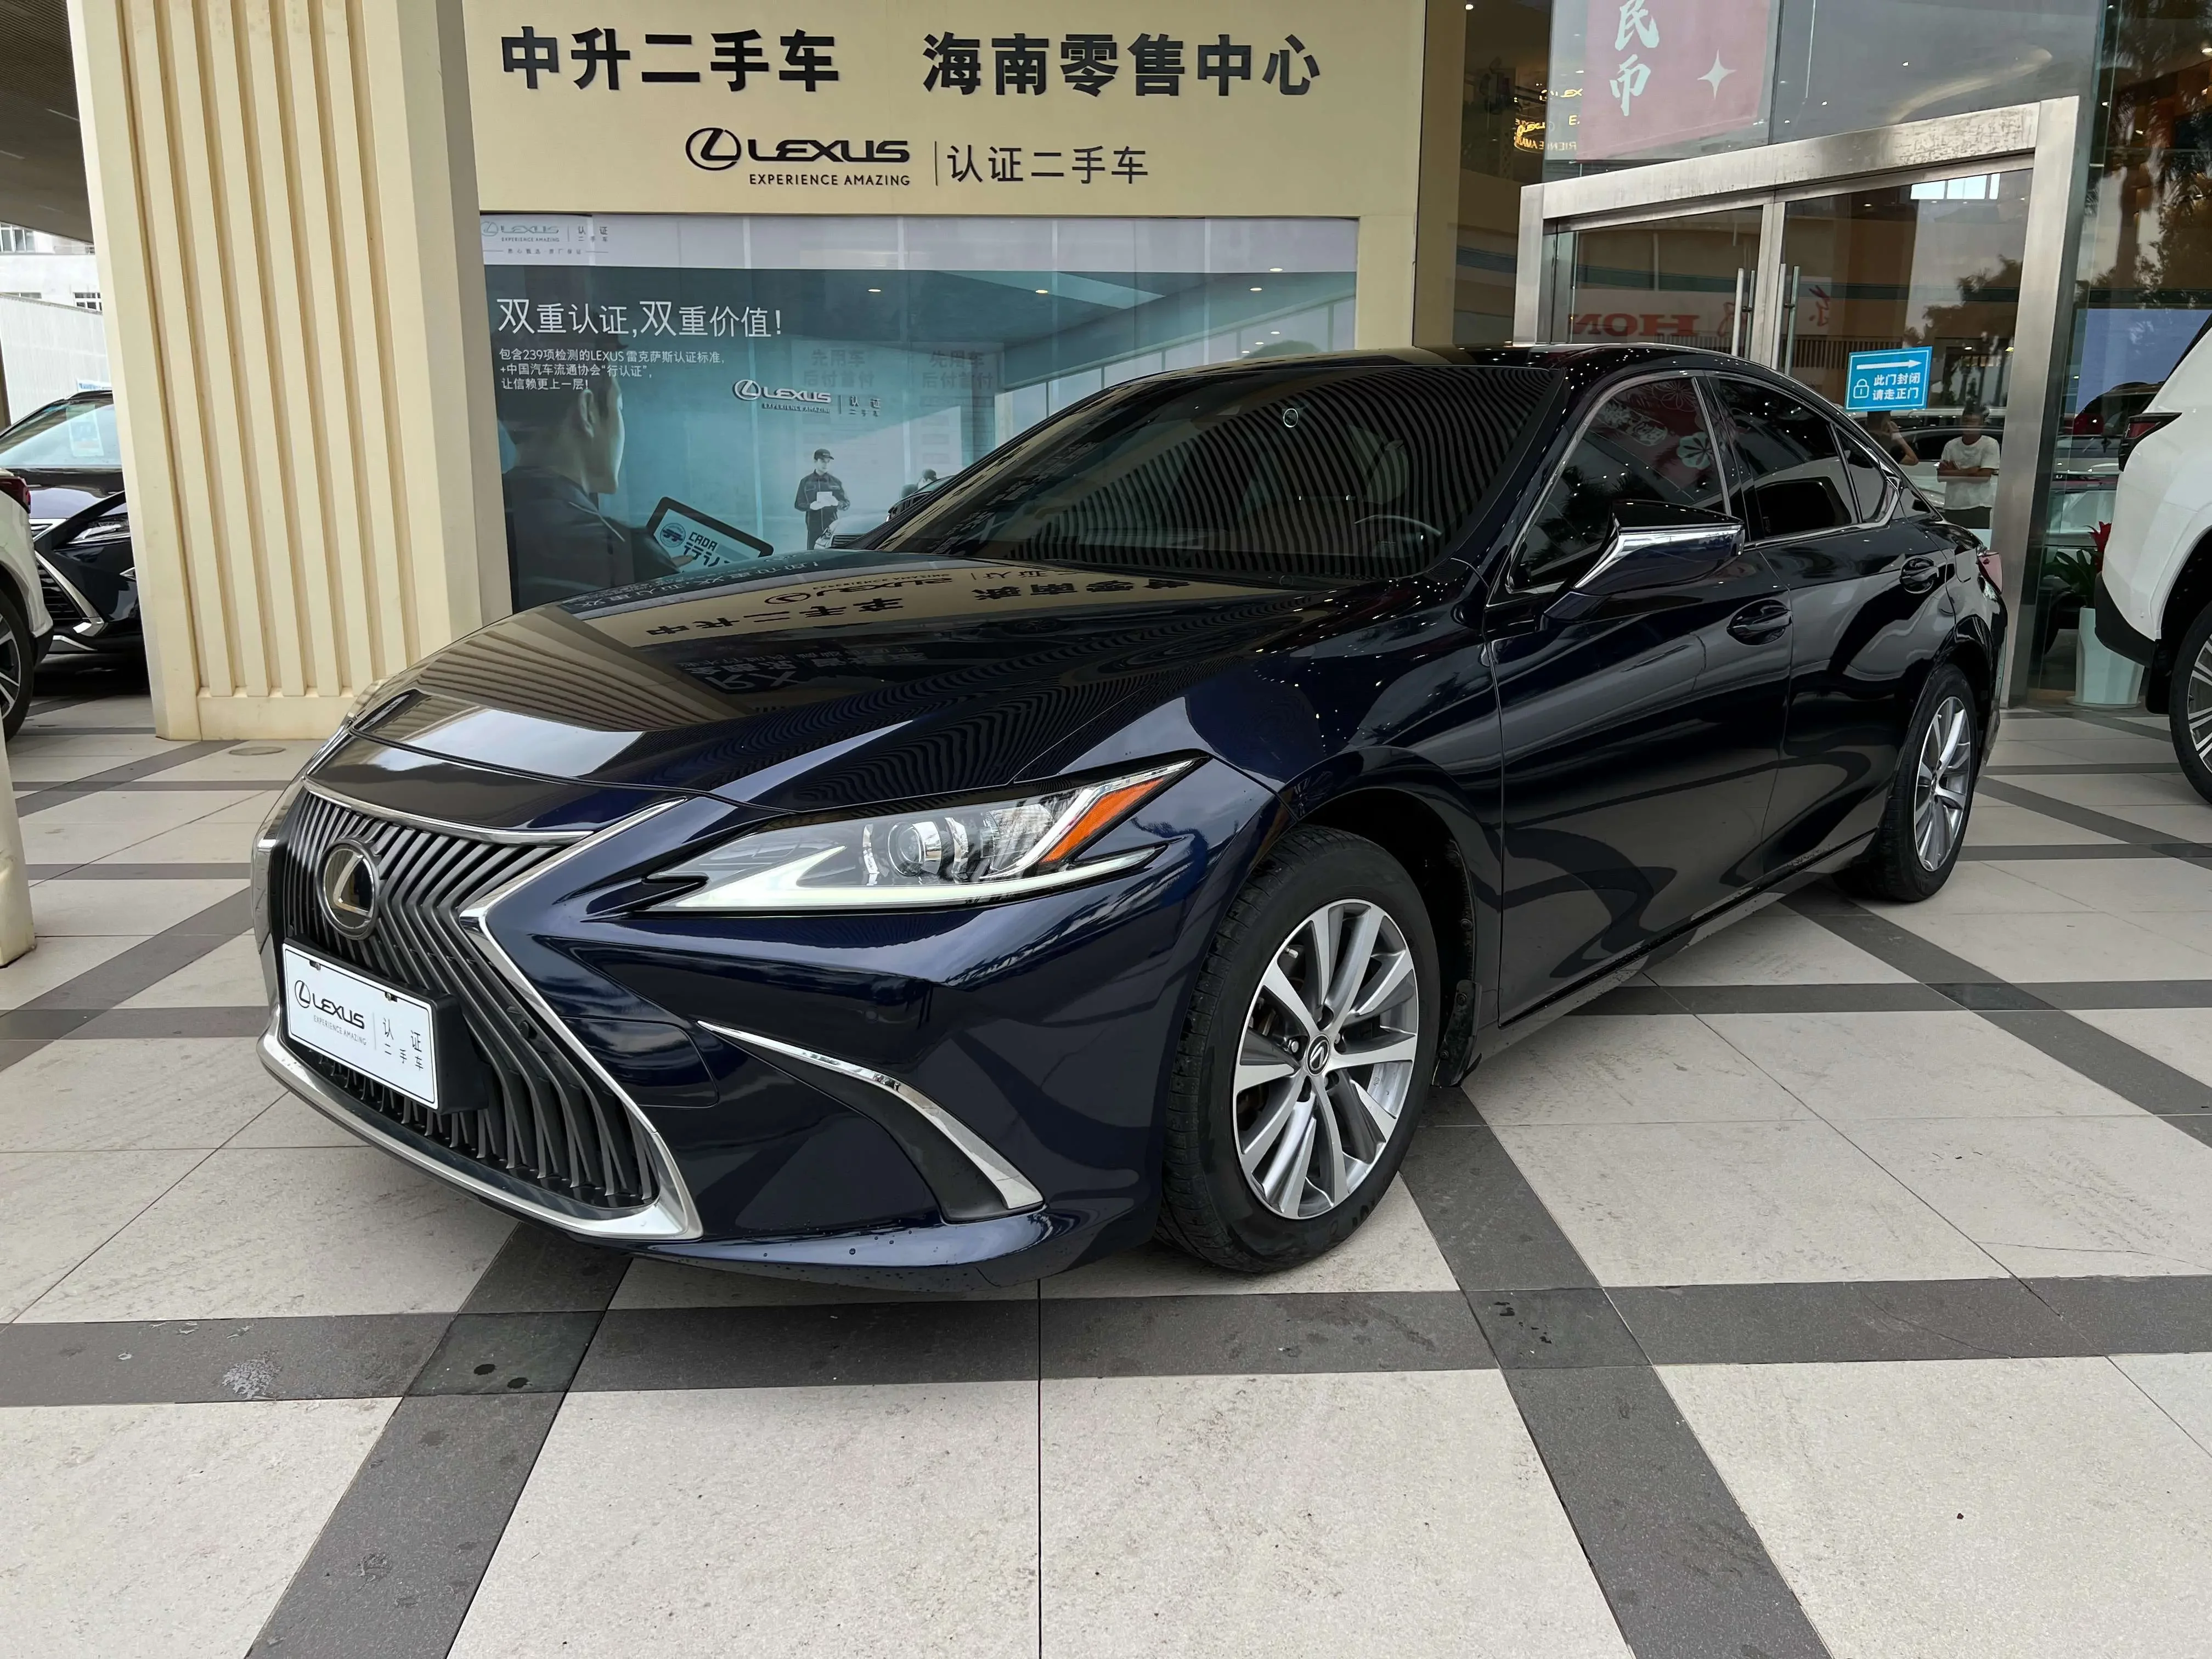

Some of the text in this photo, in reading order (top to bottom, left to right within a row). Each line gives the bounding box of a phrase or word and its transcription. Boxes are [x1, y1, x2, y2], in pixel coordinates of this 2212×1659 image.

[501, 26, 1320, 97] 中升二手车 海南零售中心
[748, 139, 910, 162] LEXUS
[946, 145, 1148, 184] 认证二手车
[749, 174, 910, 186] EXPERIENCE AMAZING
[1874, 373, 1921, 386] 此门封闭
[763, 387, 832, 403] LEXUS
[1872, 387, 1919, 401] 请走正门
[689, 532, 718, 551] CADA
[312, 993, 364, 1029] LEXUS
[313, 1015, 367, 1046] EXPERIENCE AMAZING
[383, 1017, 422, 1052] 认证
[385, 1043, 424, 1070] 二手车
